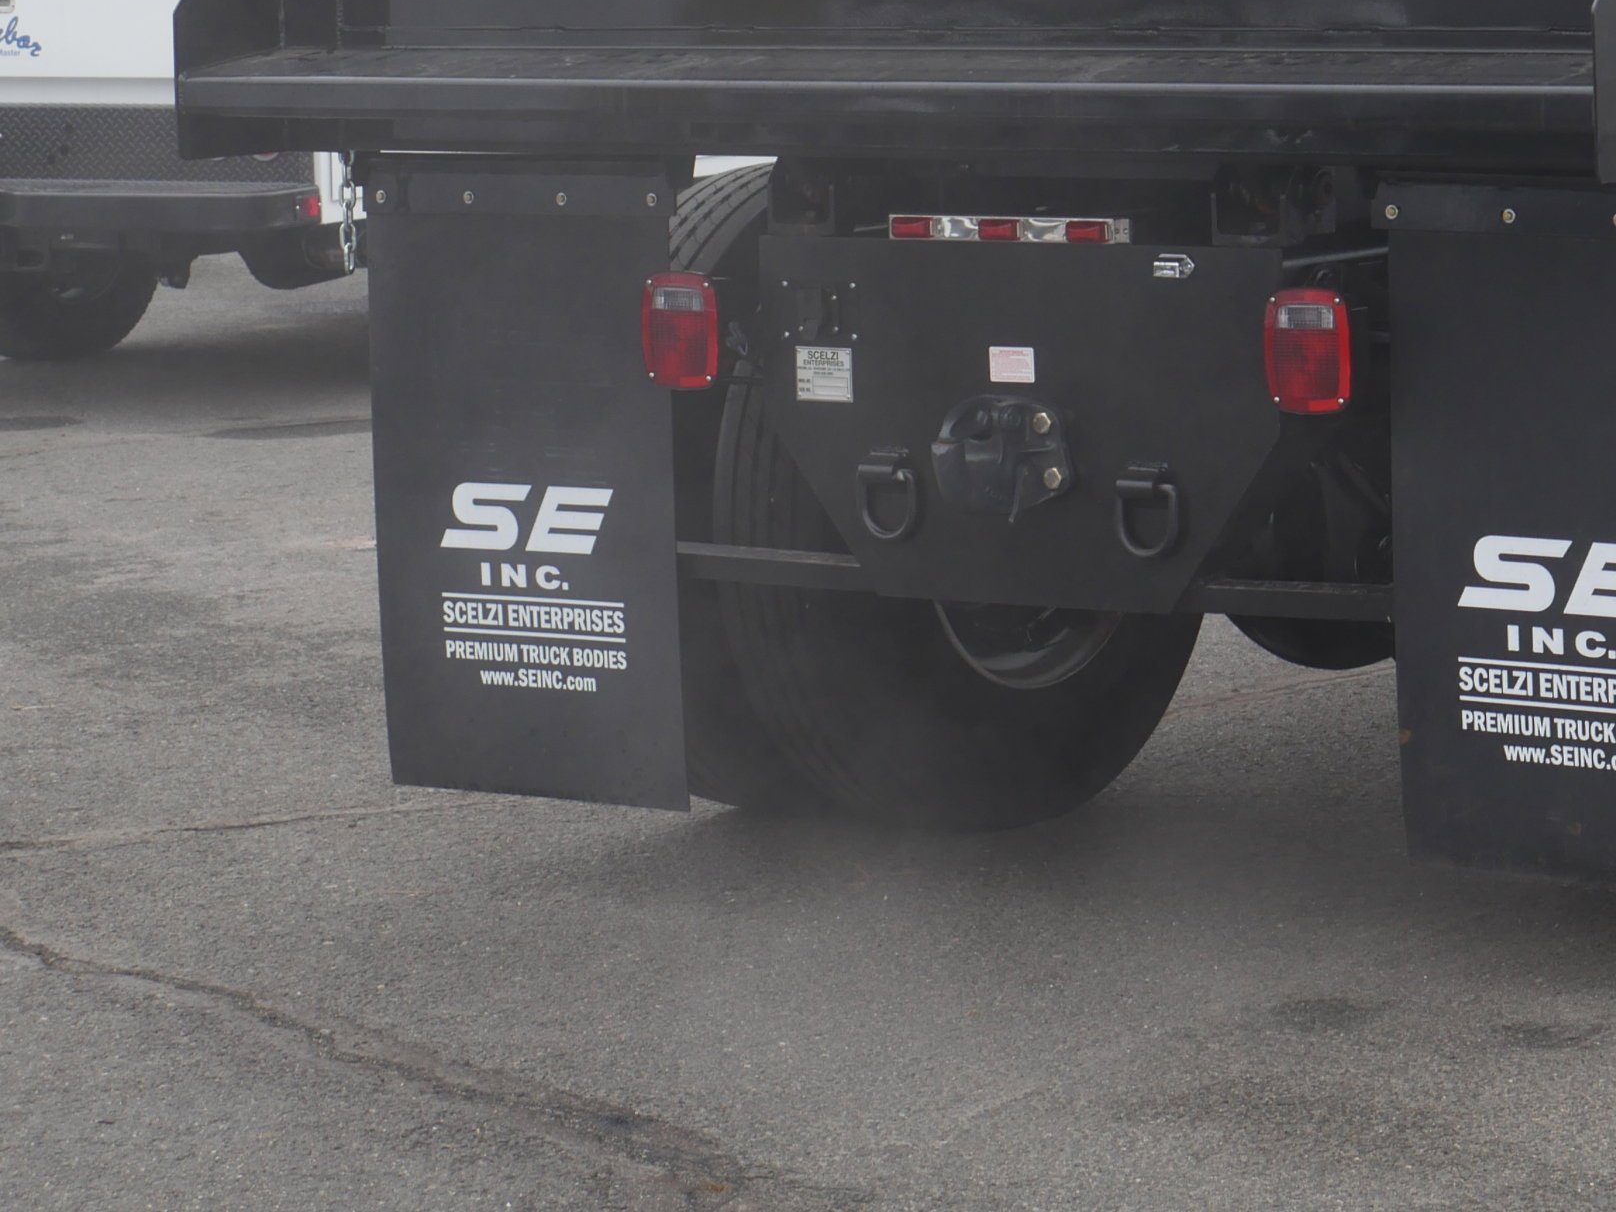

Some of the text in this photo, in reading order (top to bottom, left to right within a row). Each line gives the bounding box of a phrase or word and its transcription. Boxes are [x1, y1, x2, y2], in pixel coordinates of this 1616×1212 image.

[803, 359, 845, 367] ENTERPRISES
[807, 350, 839, 360] SCELZI
[441, 481, 613, 555] SE
[480, 563, 570, 591] INC.
[443, 601, 625, 635] SCELZI ENTERPRISES
[445, 641, 627, 670] PREMIUM TRUCK BODIES
[1507, 624, 1616, 659] INC.
[480, 668, 596, 692] www.SEINC.com
[1458, 666, 1534, 698] SCELZI
[1462, 709, 1551, 738] PREMIUM
[1554, 716, 1616, 743] TRUCK
